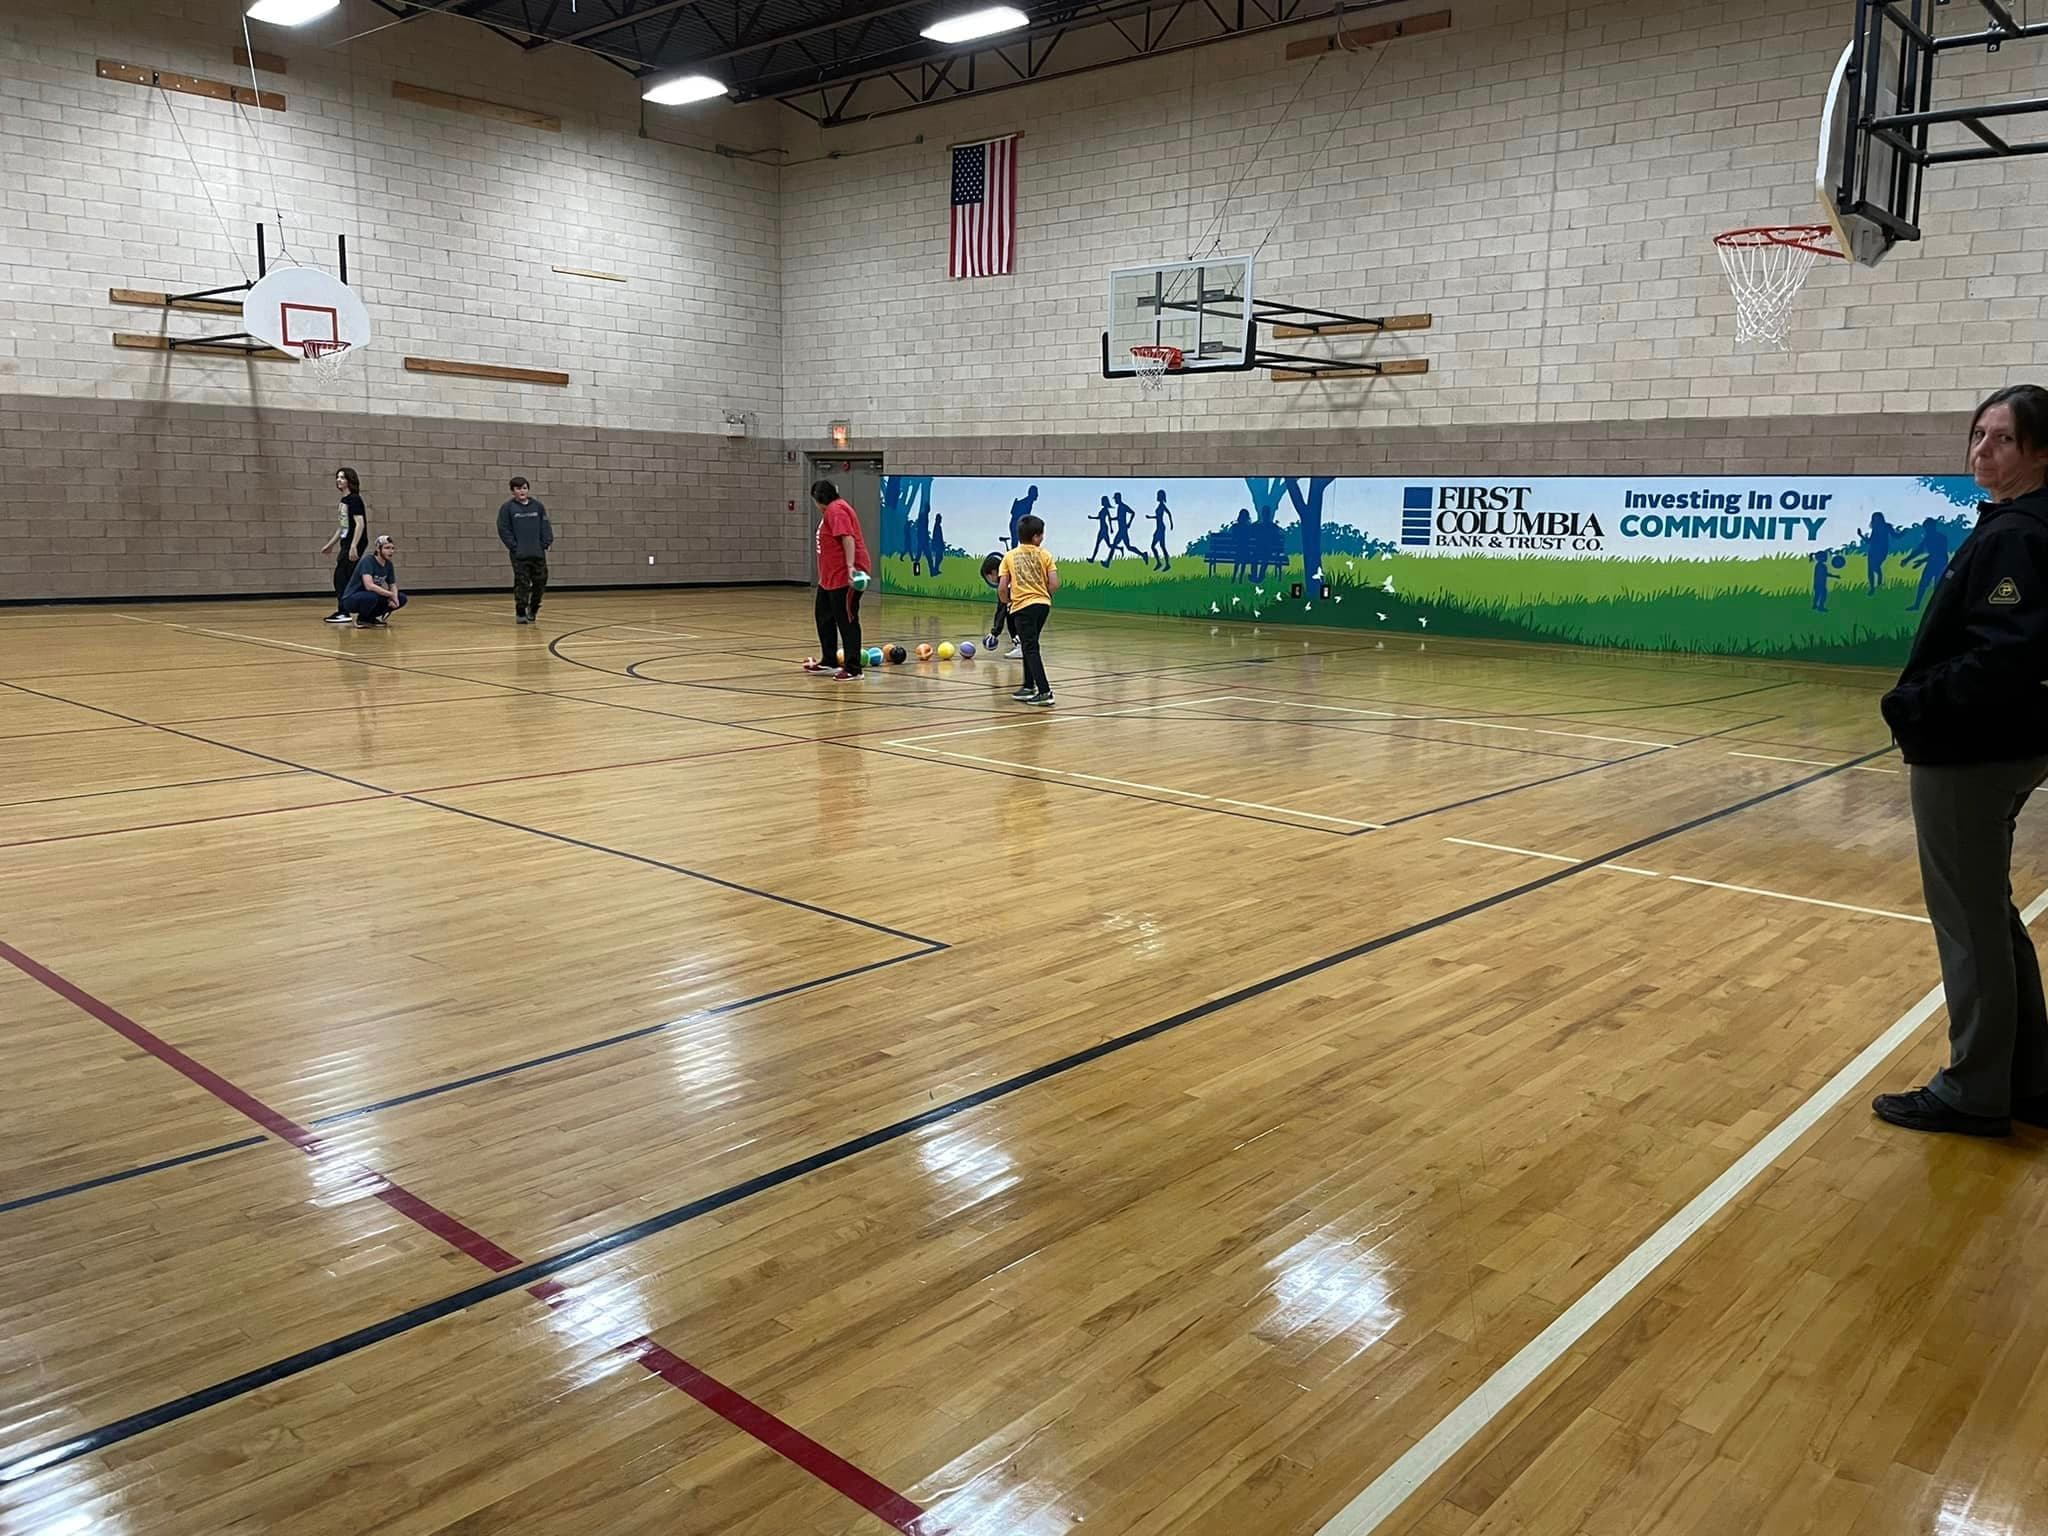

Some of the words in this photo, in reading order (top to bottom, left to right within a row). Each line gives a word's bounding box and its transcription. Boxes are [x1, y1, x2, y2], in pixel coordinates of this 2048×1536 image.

[1438, 486, 1532, 511] FIRST
[1624, 489, 1742, 515] Investing
[1748, 490, 1773, 510] In
[1779, 490, 1833, 511] Our
[1436, 510, 1605, 537] COLUMBIA
[1619, 514, 1828, 541] COMMUNITY
[1435, 535, 1484, 548] BANK
[1488, 536, 1504, 548] &
[1506, 536, 1566, 550] TRUST
[1572, 538, 1604, 551] CO.
